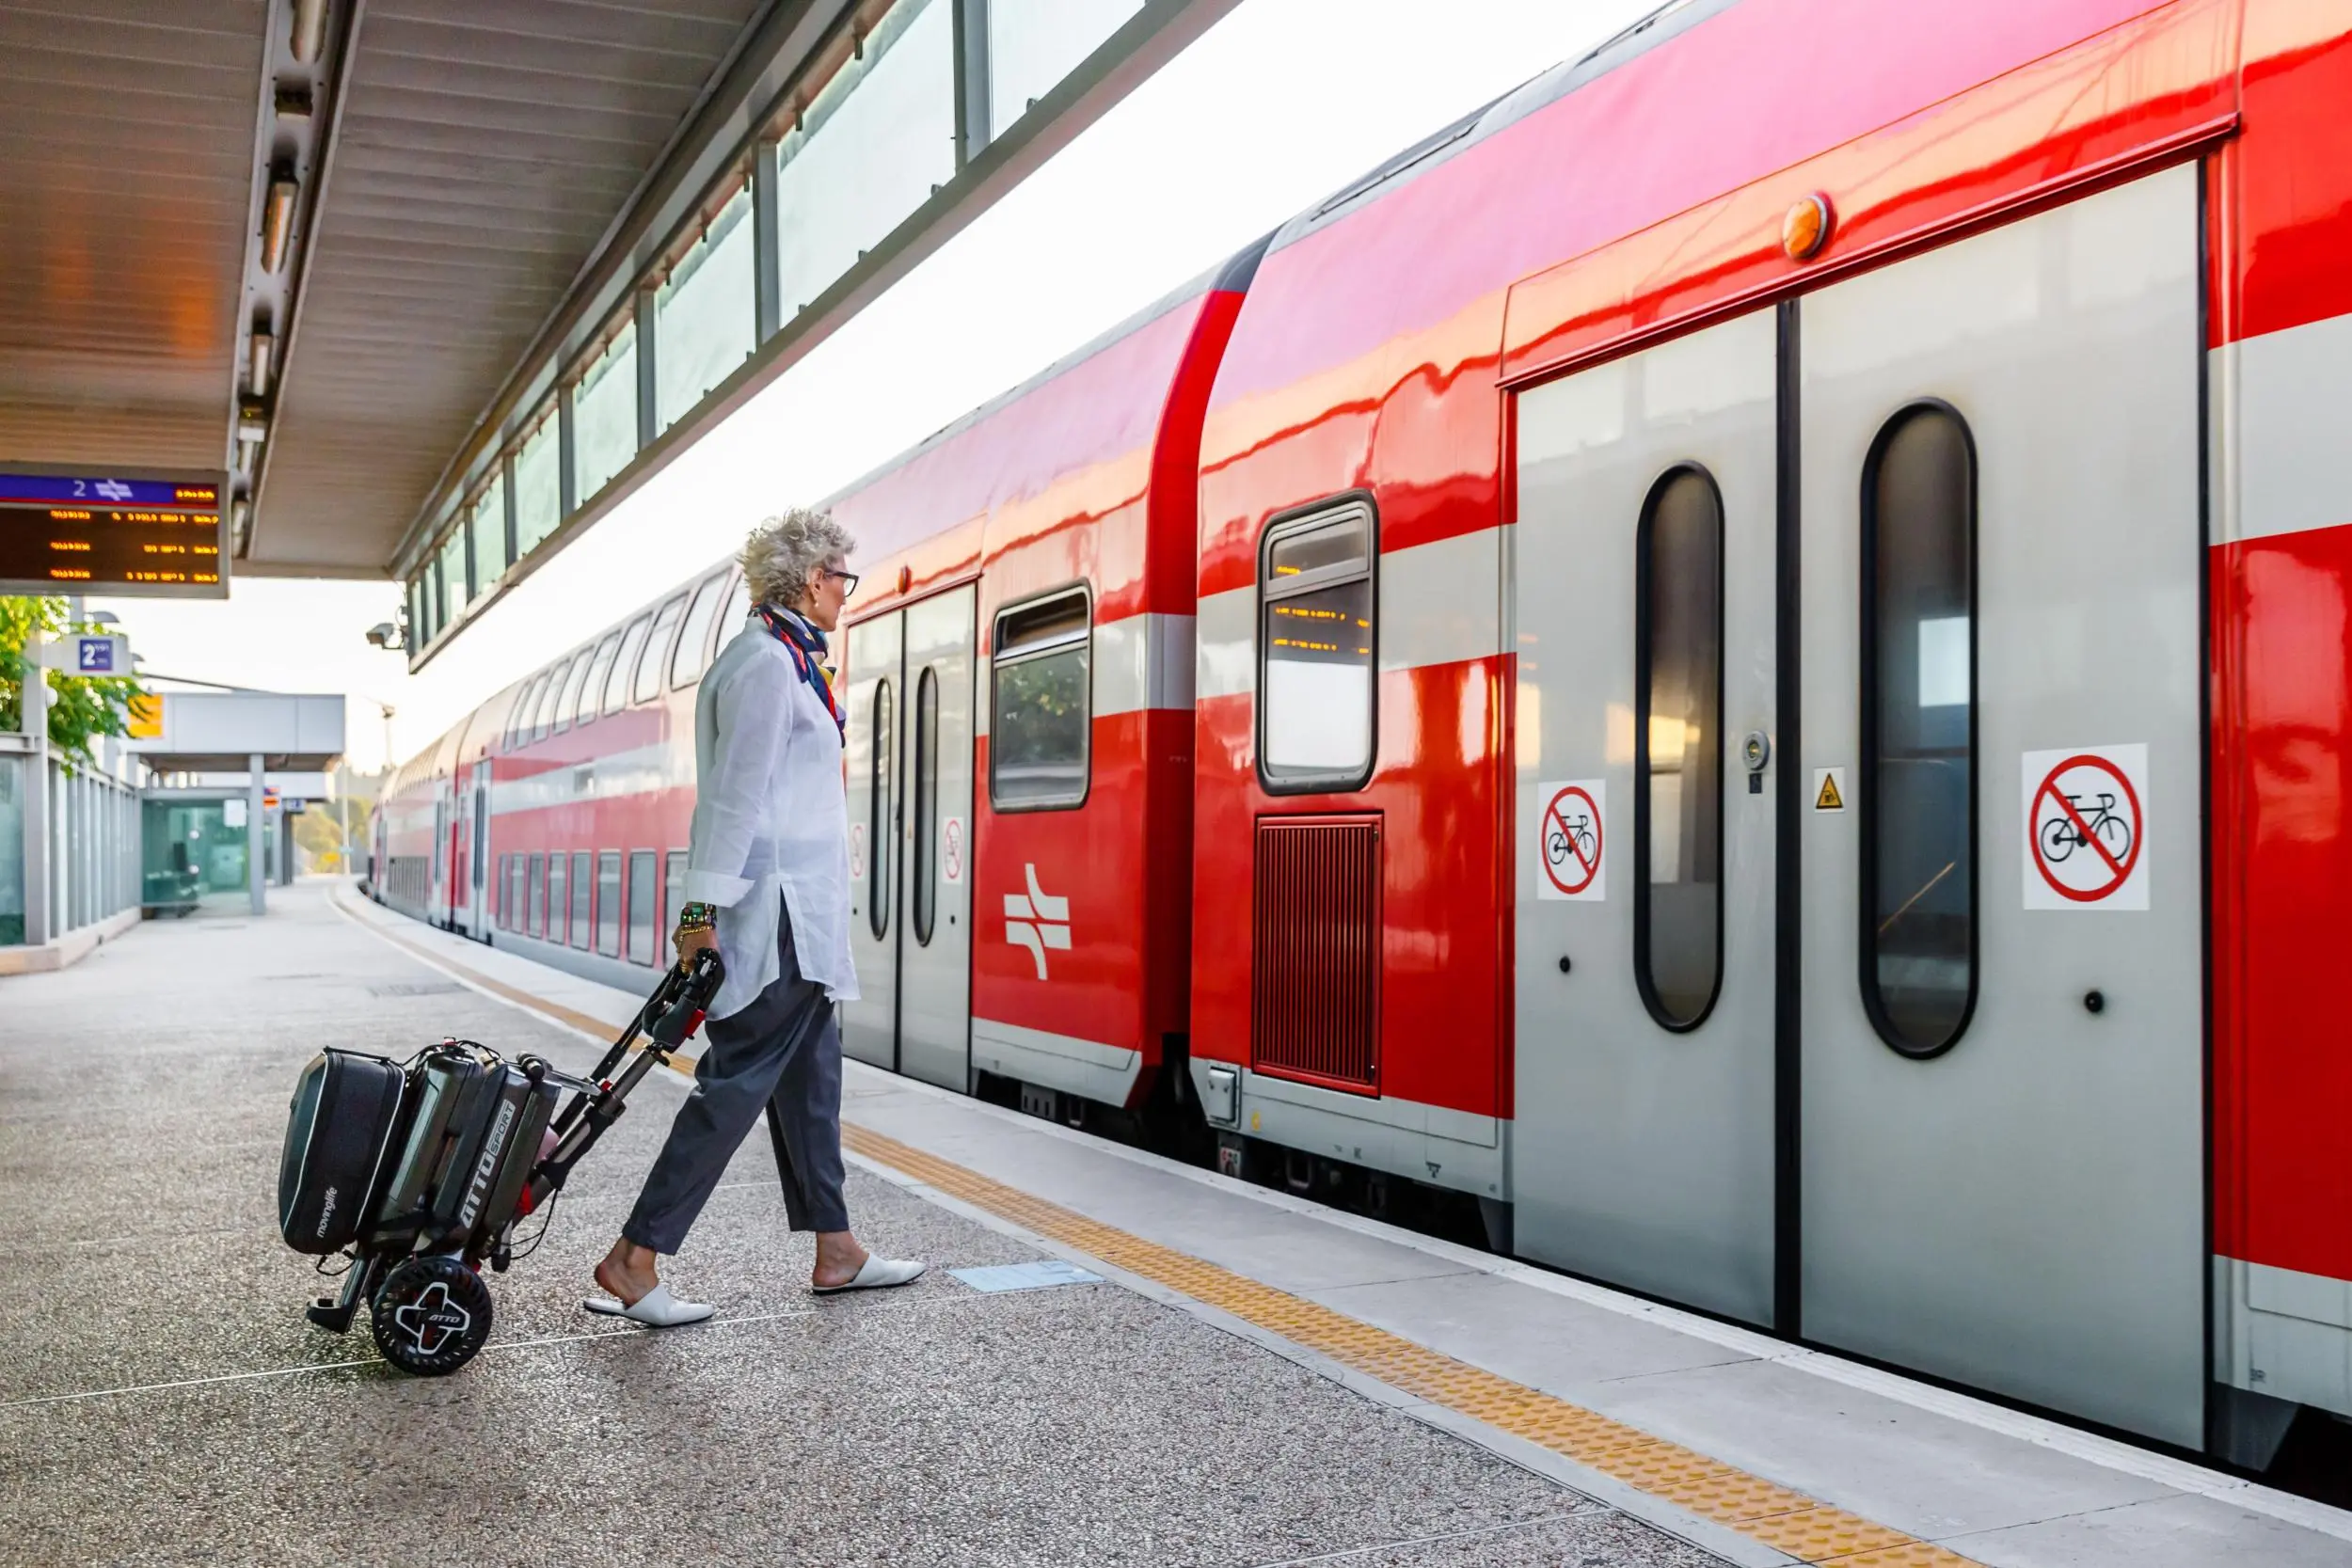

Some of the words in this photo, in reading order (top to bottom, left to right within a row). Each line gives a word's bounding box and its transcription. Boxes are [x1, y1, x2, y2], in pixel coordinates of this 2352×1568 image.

[73, 480, 87, 497] 2
[83, 643, 95, 666] 2
[461, 1150, 496, 1228] ATTO
[489, 1101, 515, 1155] SPORT
[316, 1186, 338, 1238] movinglife
[428, 1314, 461, 1323] ATTO
